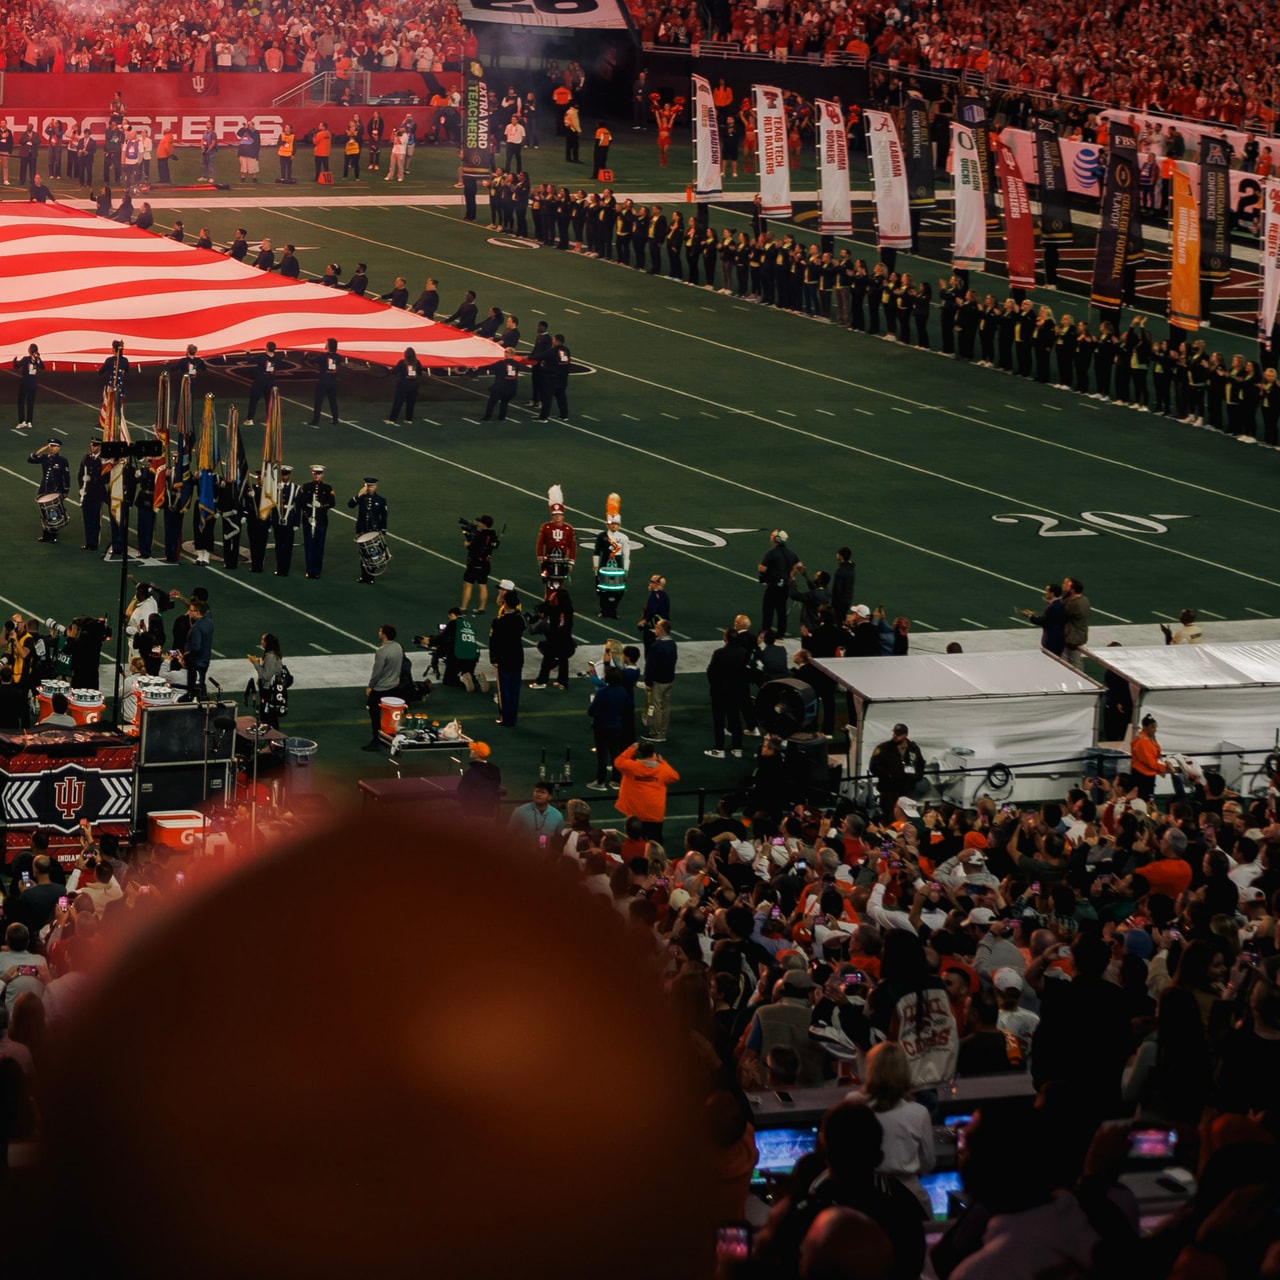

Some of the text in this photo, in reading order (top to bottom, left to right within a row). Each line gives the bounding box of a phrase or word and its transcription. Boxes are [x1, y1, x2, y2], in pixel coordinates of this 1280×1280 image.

[466, 86, 478, 150] TEACHERS
[477, 81, 489, 150] EXTRA YARD
[763, 116, 775, 175] RED RAIDERS
[773, 116, 785, 167] TEXAS TECH
[835, 130, 847, 171] OKLAHOMA
[888, 140, 902, 178] ALABAMA
[976, 128, 988, 170] MOUNTAIN
[1114, 135, 1137, 147] FBS
[960, 158, 970, 185] DUCKS
[970, 159, 981, 191] OREGON
[1042, 140, 1056, 191] CONFERENCE
[1007, 175, 1021, 219] HOOSIERS
[1109, 191, 1123, 229] PLAYOFF
[1207, 171, 1216, 221] CONFERENCE
[1111, 193, 1132, 279] COLLEGE FOOTBALL
[86, 712, 98, 724] G
[392, 711, 401, 721] G
[180, 830, 194, 844] G
